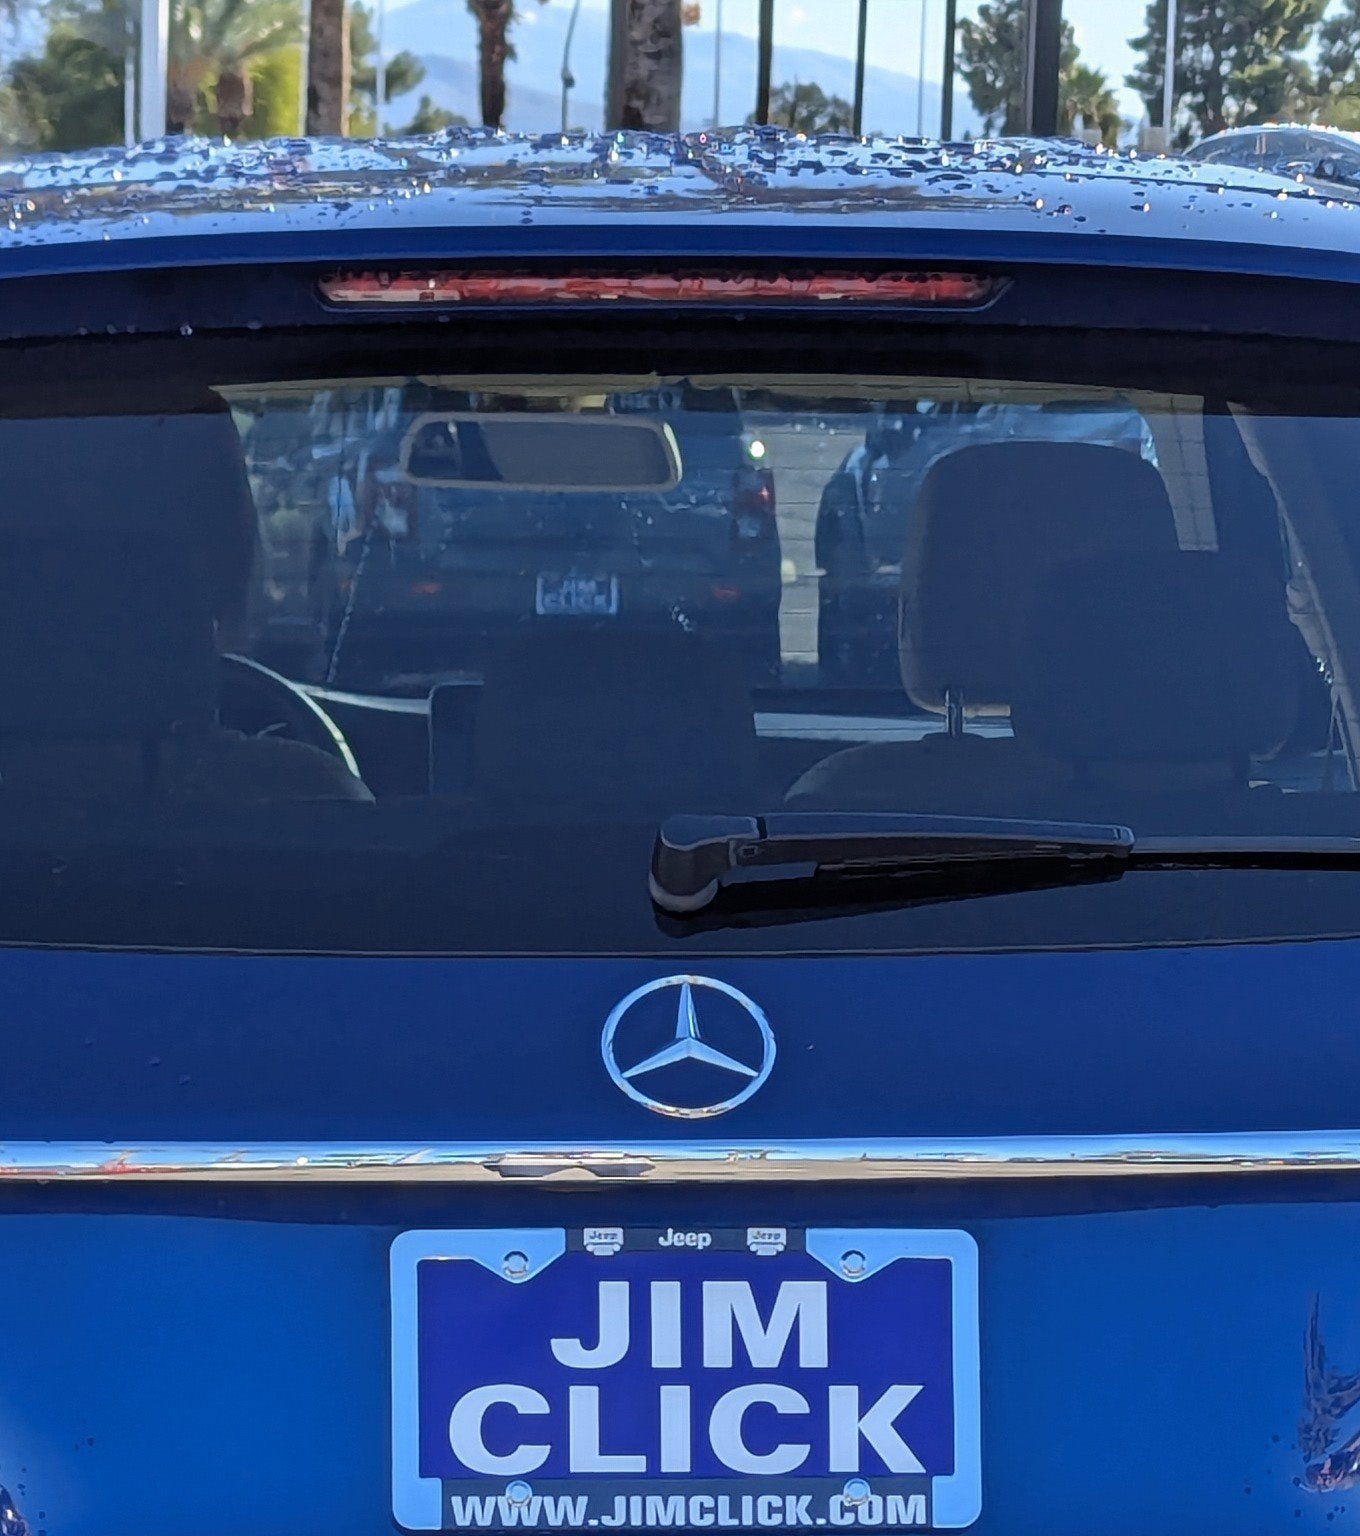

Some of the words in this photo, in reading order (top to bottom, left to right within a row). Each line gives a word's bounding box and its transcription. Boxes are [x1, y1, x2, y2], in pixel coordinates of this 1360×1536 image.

[658, 1227, 712, 1250] Jeep
[550, 1279, 829, 1369] JIM
[447, 1382, 927, 1475] CLICK
[451, 1493, 927, 1528] WWW.JIMCLICK.COM
